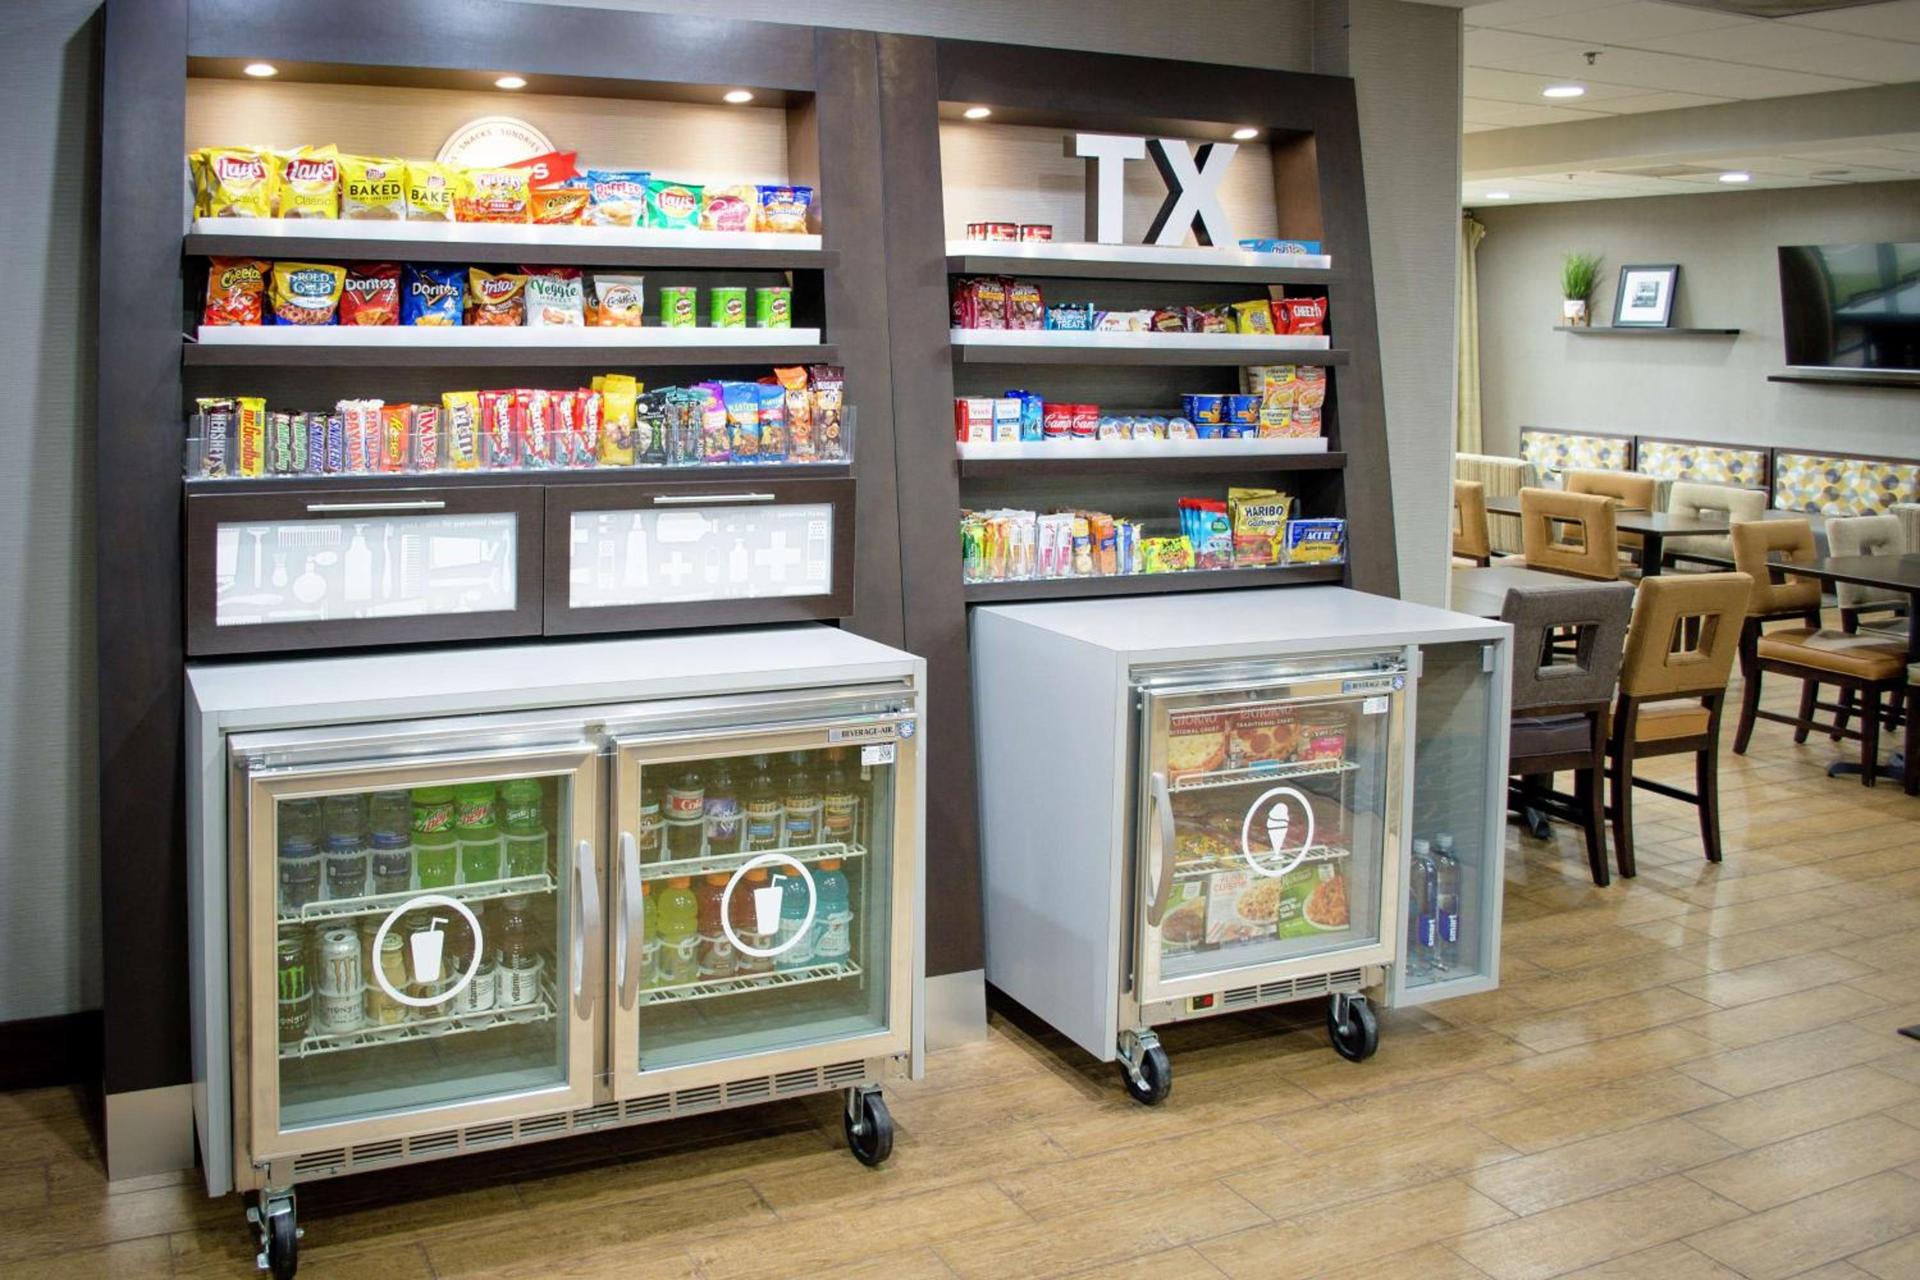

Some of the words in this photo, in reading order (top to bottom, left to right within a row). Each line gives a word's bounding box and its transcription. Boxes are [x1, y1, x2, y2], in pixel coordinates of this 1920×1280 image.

[350, 184, 400, 196] BAKED
[1072, 133, 1239, 248] TX
[345, 278, 397, 291] Doritos
[412, 282, 459, 297] Doritos
[531, 279, 578, 298] Veggie
[328, 420, 341, 469] SNICKERS
[419, 409, 437, 455] TWIX
[310, 422, 323, 472] SNICKERS
[1244, 505, 1284, 516] HARIBO
[1428, 918, 1436, 947] smart
[1448, 913, 1457, 942] smart
